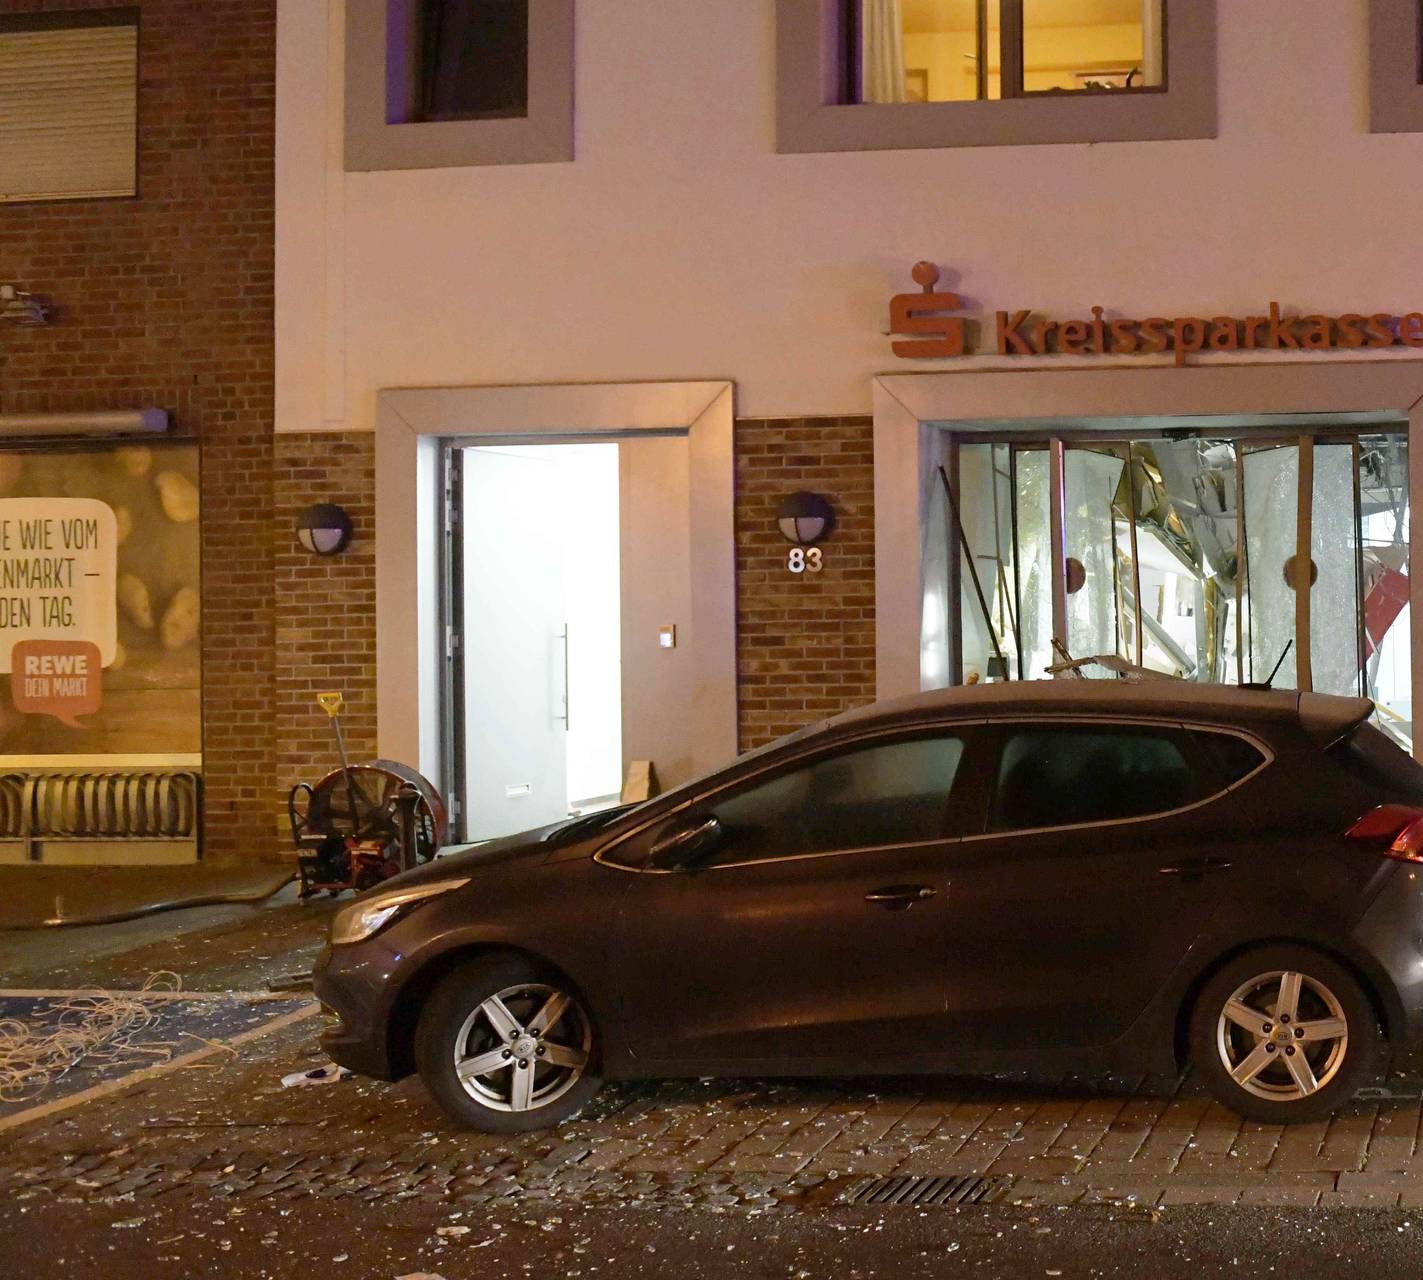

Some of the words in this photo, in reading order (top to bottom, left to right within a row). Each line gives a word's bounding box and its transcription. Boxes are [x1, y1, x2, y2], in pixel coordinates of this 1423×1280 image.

[0, 519, 11, 551] E
[19, 518, 53, 550] WIE
[61, 518, 98, 550] VOM
[0, 557, 76, 589] NMARKT
[788, 547, 823, 573] 83
[39, 596, 76, 628] TAG.
[25, 655, 88, 675] REWE
[24, 677, 49, 697] DEIN
[53, 677, 88, 697] MARKT
